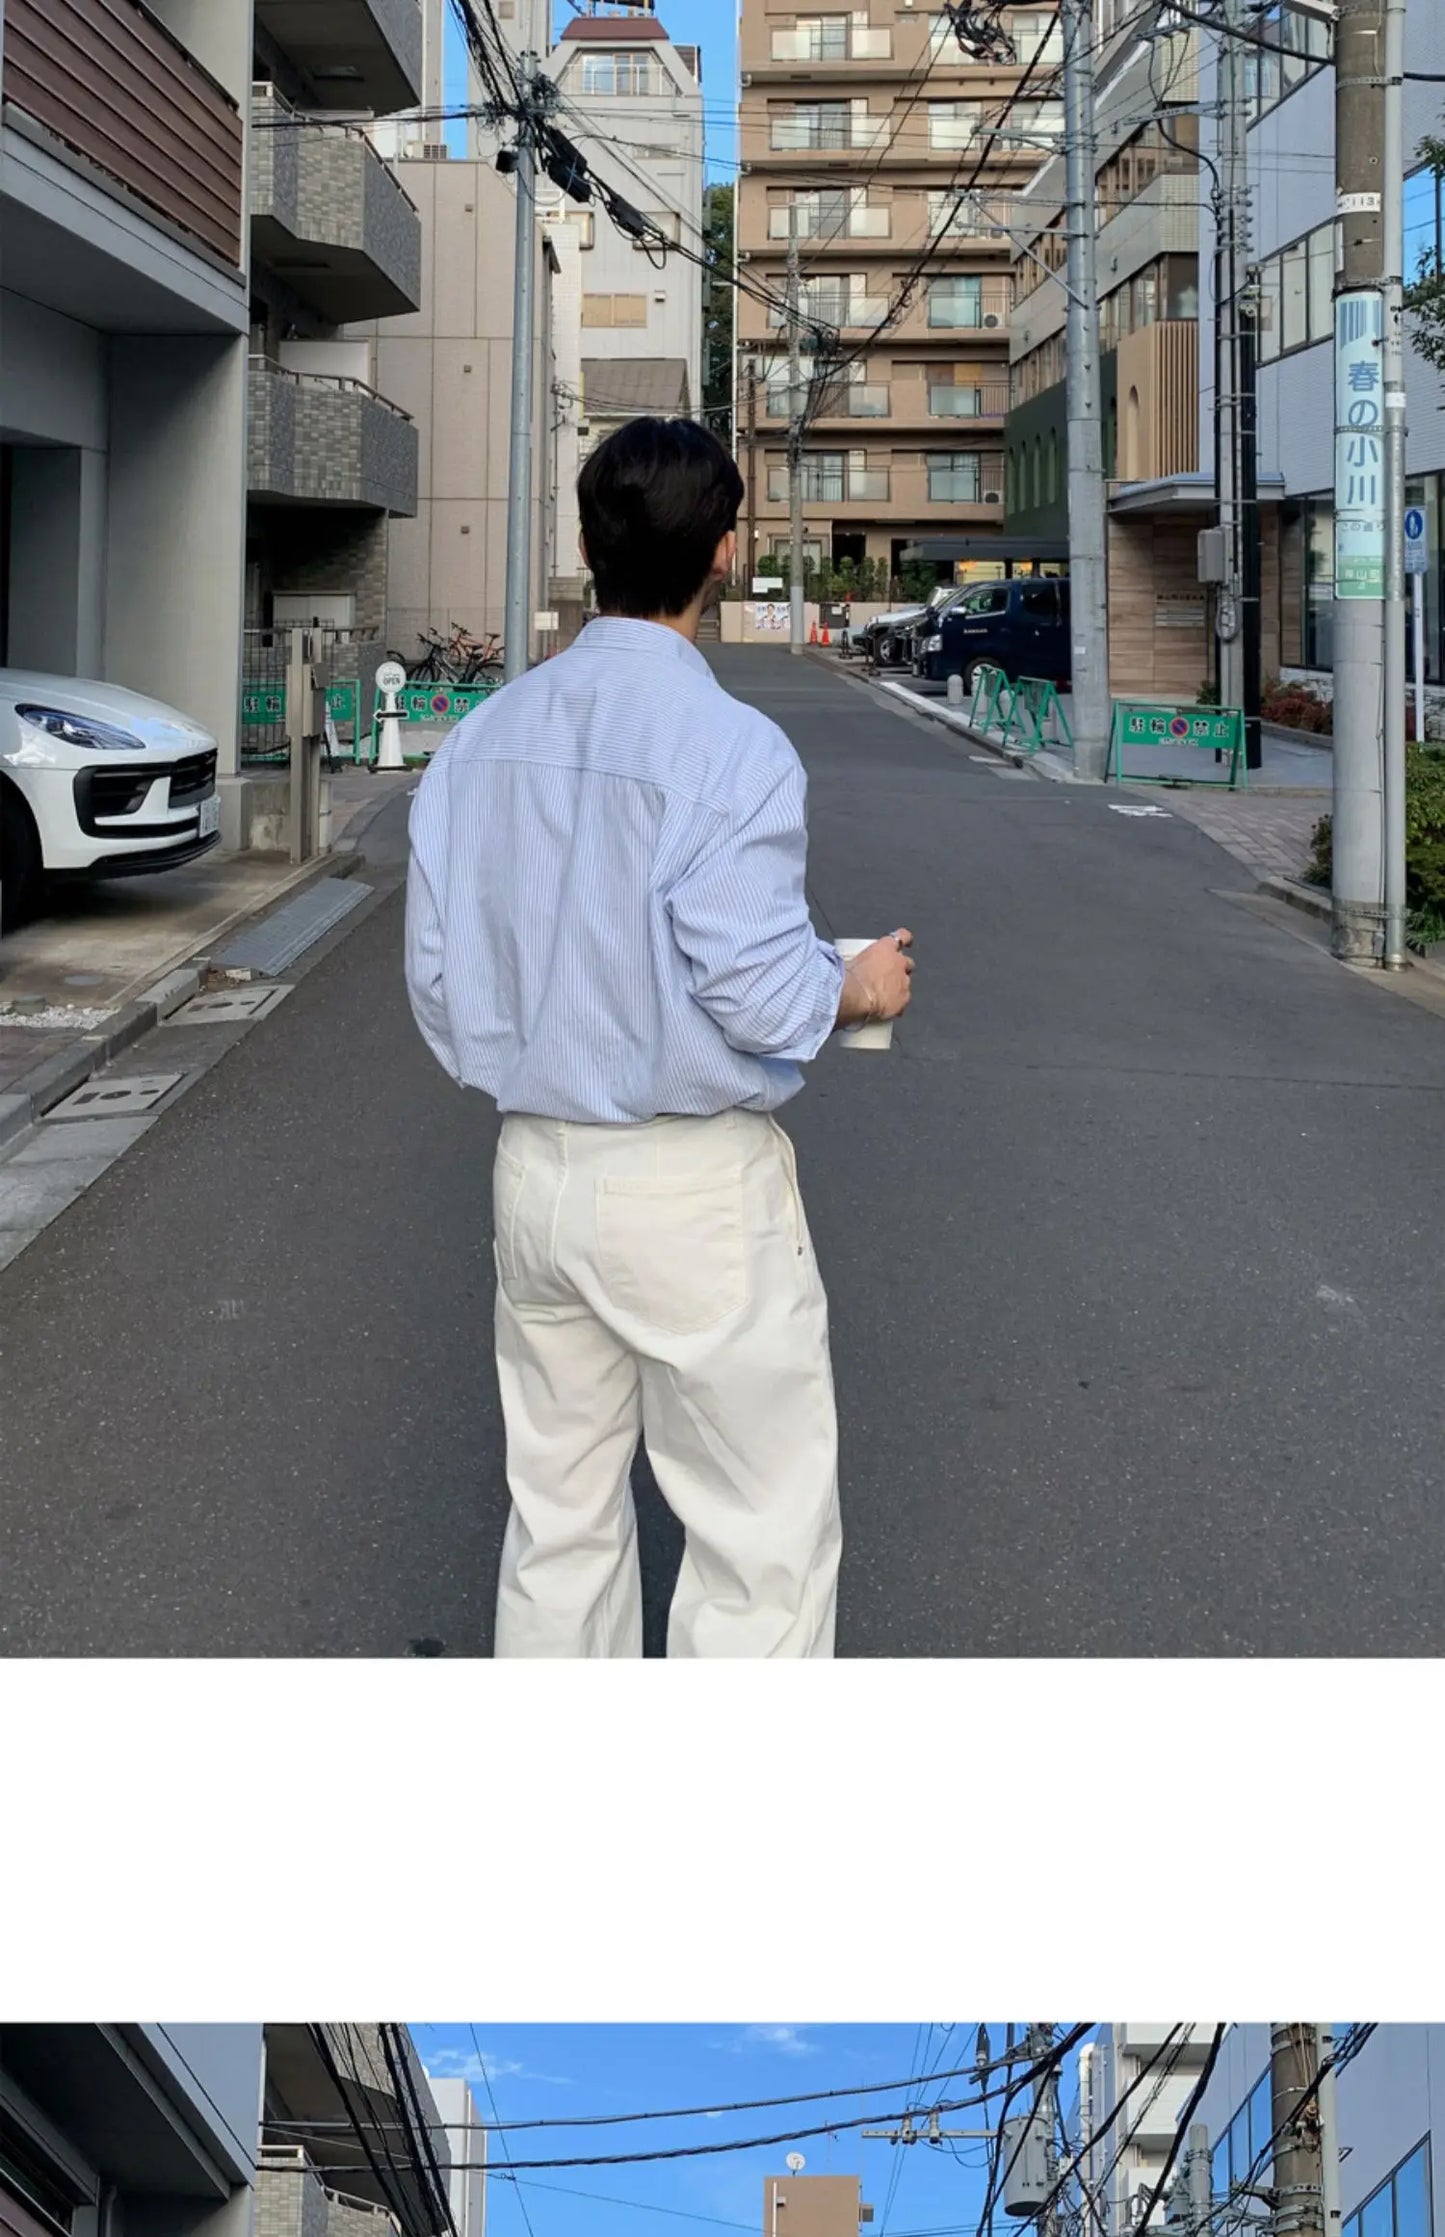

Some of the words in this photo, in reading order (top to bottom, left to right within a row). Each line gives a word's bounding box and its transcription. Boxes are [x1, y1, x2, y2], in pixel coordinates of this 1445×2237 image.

[1347, 360, 1379, 505] 春の小川
[383, 677, 400, 685] OPEN
